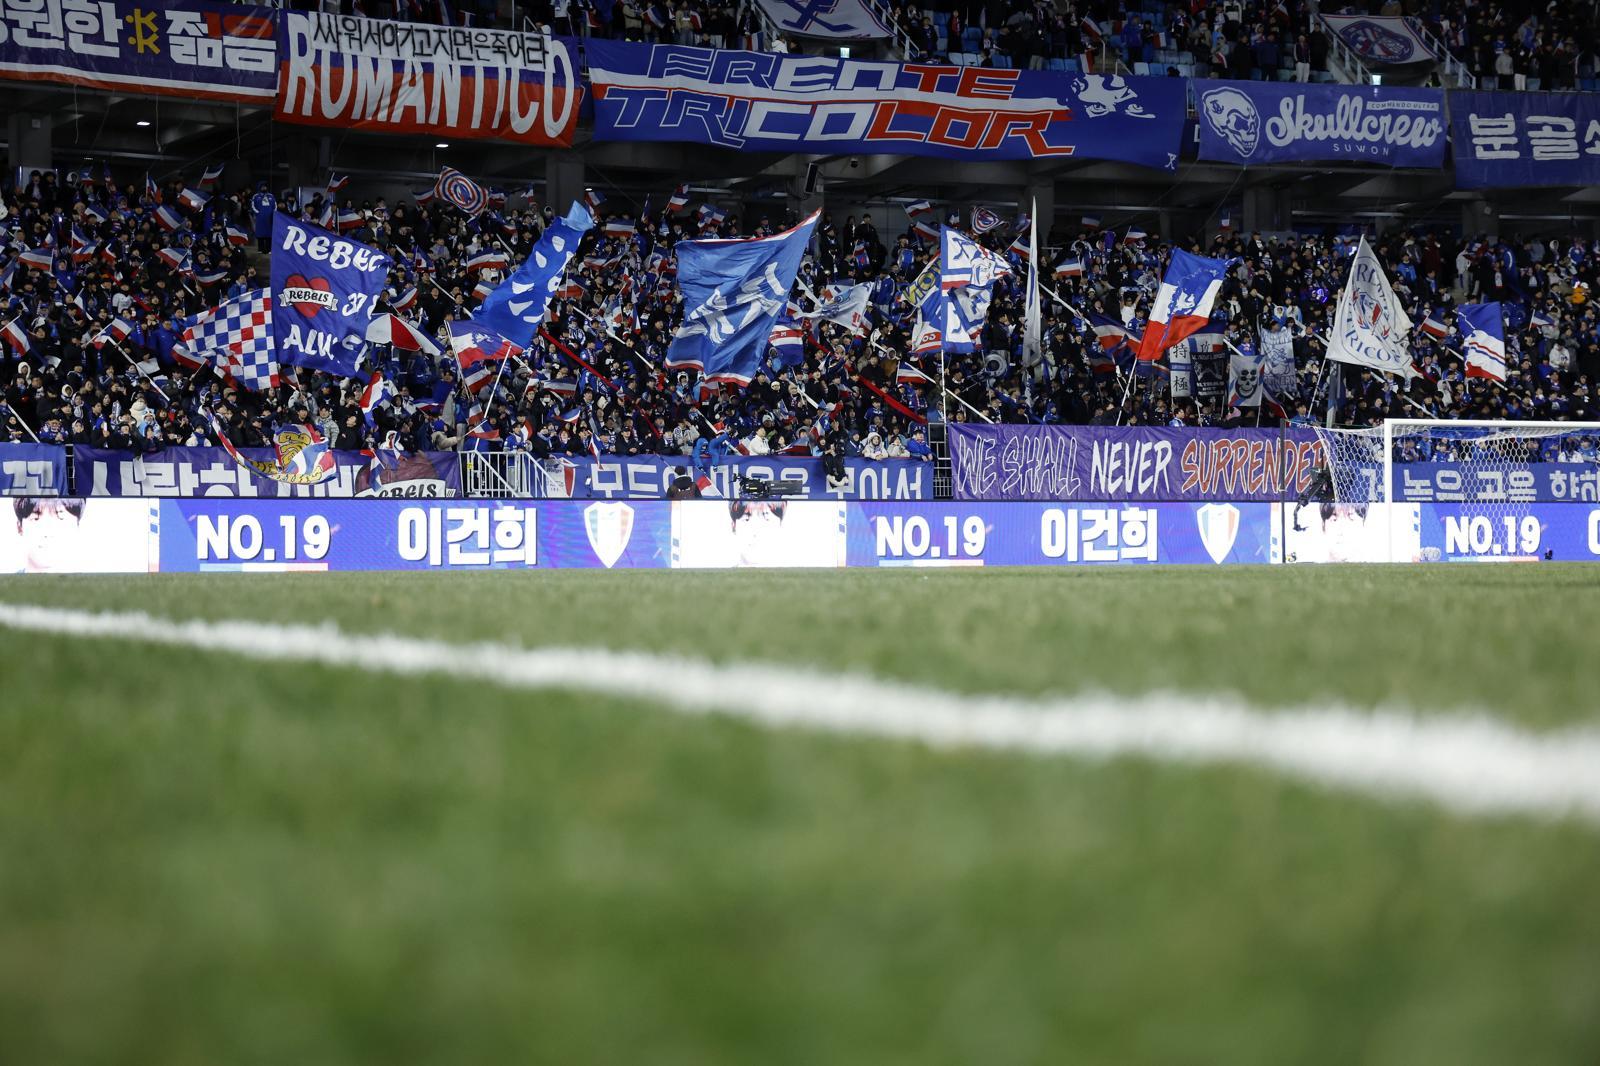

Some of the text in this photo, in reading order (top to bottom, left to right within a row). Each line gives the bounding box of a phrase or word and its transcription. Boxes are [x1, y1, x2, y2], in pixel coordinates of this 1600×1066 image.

[603, 86, 1076, 158] TRICOLOR
[1265, 94, 1443, 149] Skullcrew
[1333, 143, 1390, 156] SUWON
[957, 434, 997, 495] WE
[1002, 435, 1081, 496] SHALL
[1090, 439, 1173, 495] NEVER
[197, 514, 331, 561] NO.19
[398, 505, 537, 566] 이건희
[876, 515, 986, 558] NO.19
[1041, 506, 1158, 562] 이건희
[1445, 515, 1541, 555] NO.19
